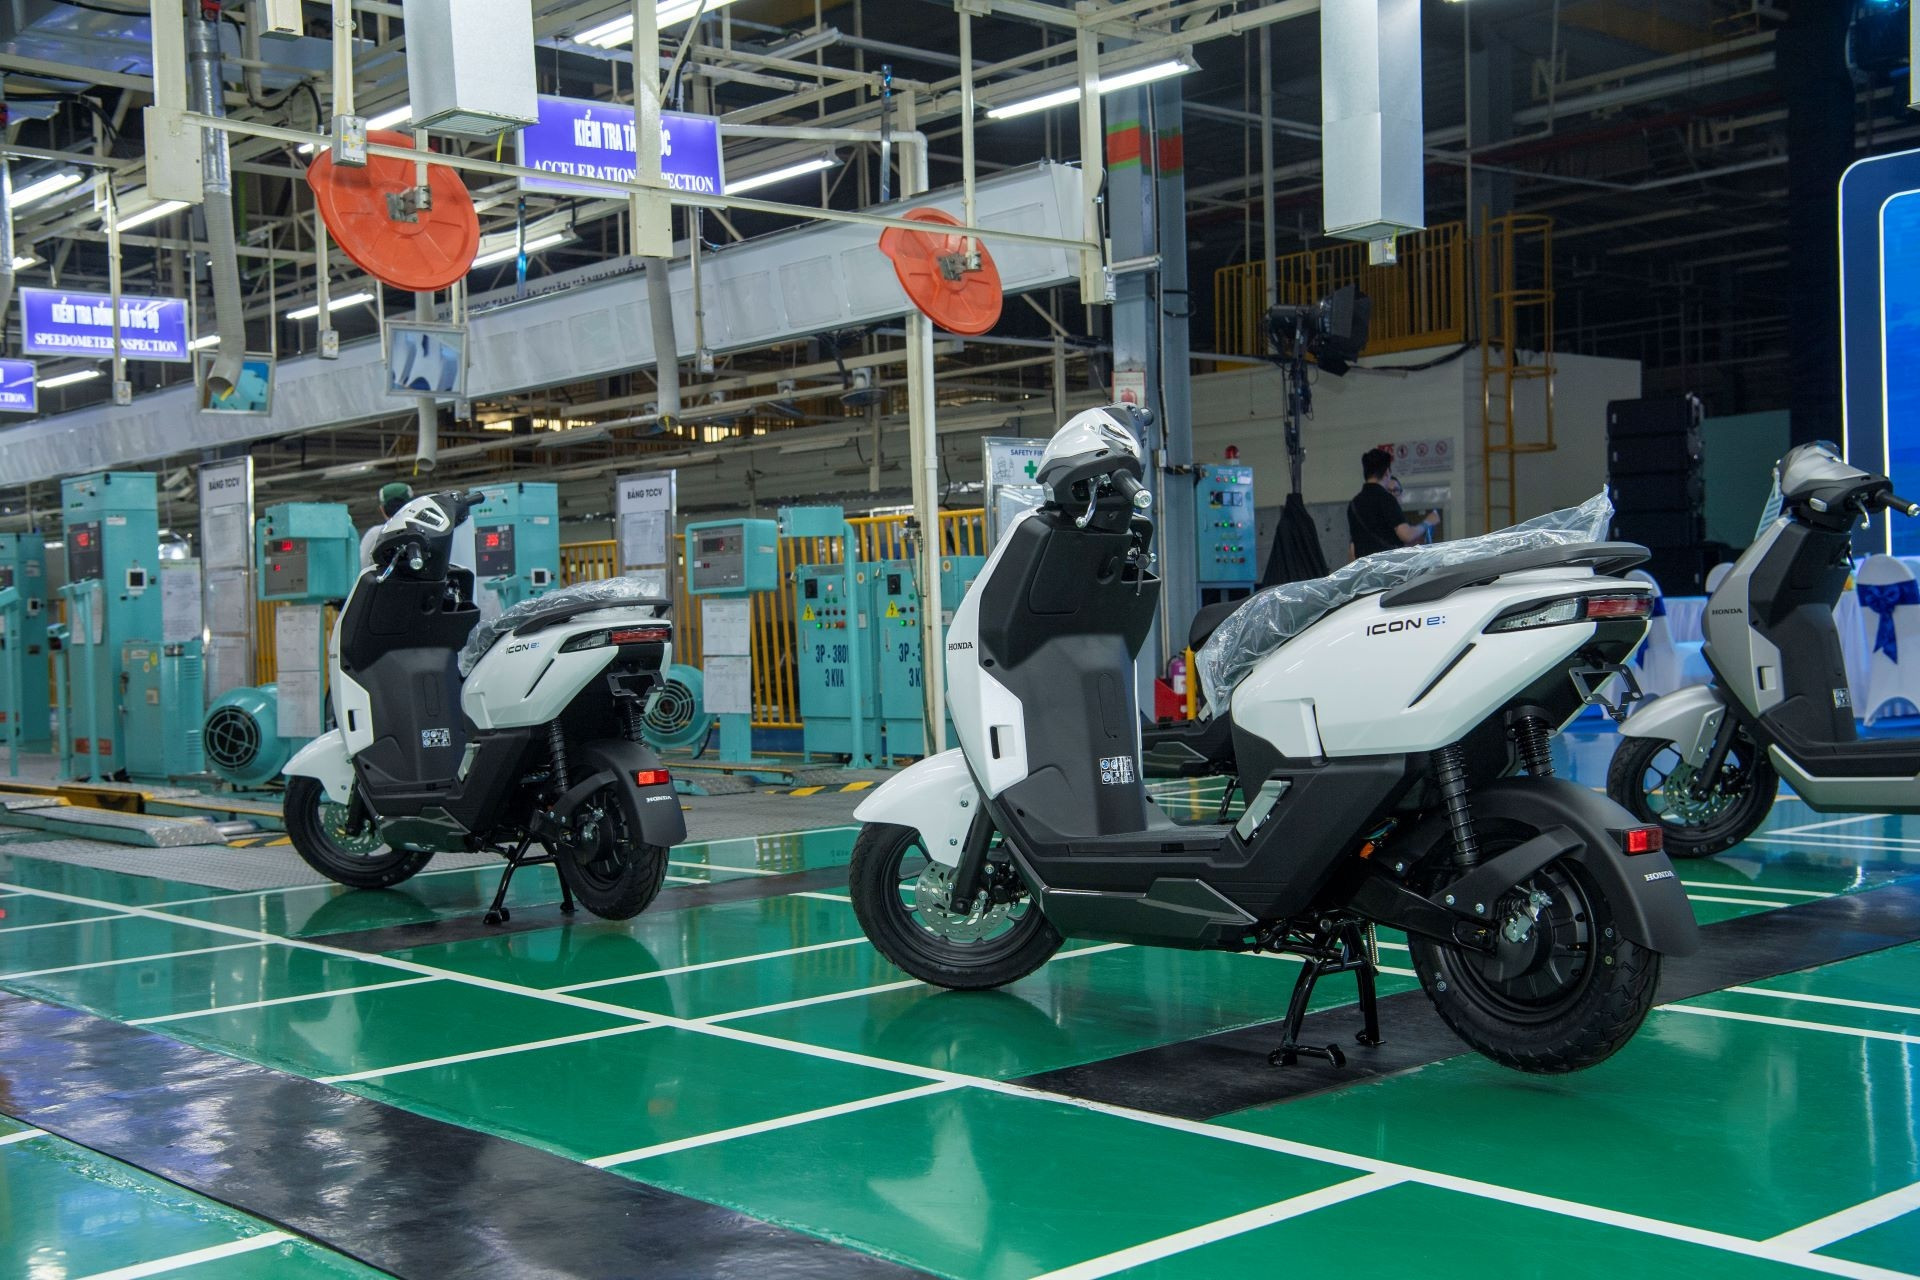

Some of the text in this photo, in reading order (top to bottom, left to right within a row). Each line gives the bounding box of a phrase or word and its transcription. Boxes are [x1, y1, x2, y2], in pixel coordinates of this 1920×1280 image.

[574, 109, 601, 148] KIỂM
[602, 122, 623, 151] TRA
[120, 338, 178, 352] NSPECTION
[1010, 449, 1032, 457] SAFETY
[1366, 617, 1422, 636] ICON
[506, 643, 529, 654] ICON
[948, 641, 973, 651] HONDA
[815, 644, 826, 663] 3P
[831, 668, 845, 687] KVA
[1643, 870, 1674, 882] HONDA
